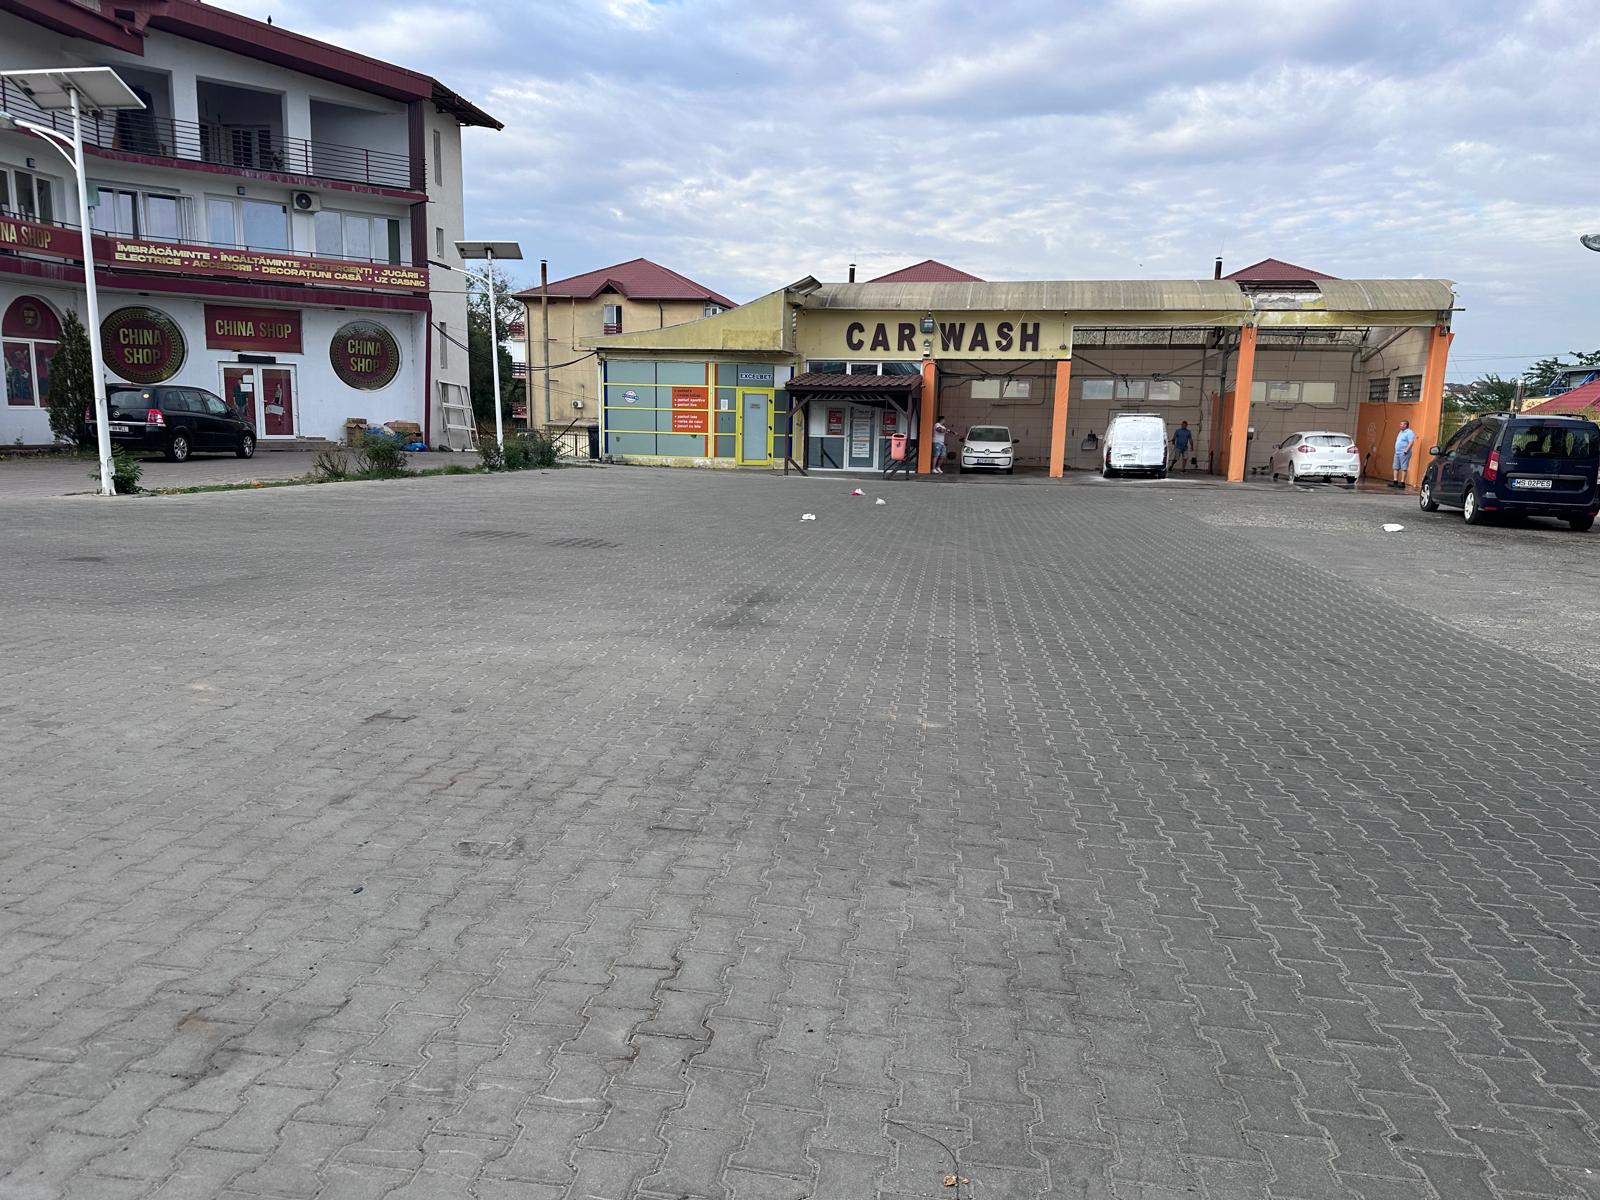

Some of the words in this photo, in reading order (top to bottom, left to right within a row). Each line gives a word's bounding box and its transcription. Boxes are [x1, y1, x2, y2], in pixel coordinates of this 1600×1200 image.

[20, 225, 51, 249] SHOP
[115, 252, 182, 266] ELECTRICE
[192, 260, 252, 272] ACCESORII
[391, 278, 426, 287] CASNIC
[117, 241, 211, 260] ÎMBRĂCĂMINTE
[381, 269, 419, 279] JUCĂRII
[119, 328, 163, 345] CHINA
[215, 319, 255, 337] CHINA
[259, 322, 292, 339] SHOP
[846, 321, 917, 351] CAR
[939, 322, 1040, 351] WASH
[124, 348, 162, 364] SHOP
[347, 339, 382, 356] CHINA
[350, 357, 380, 373] SHOP
